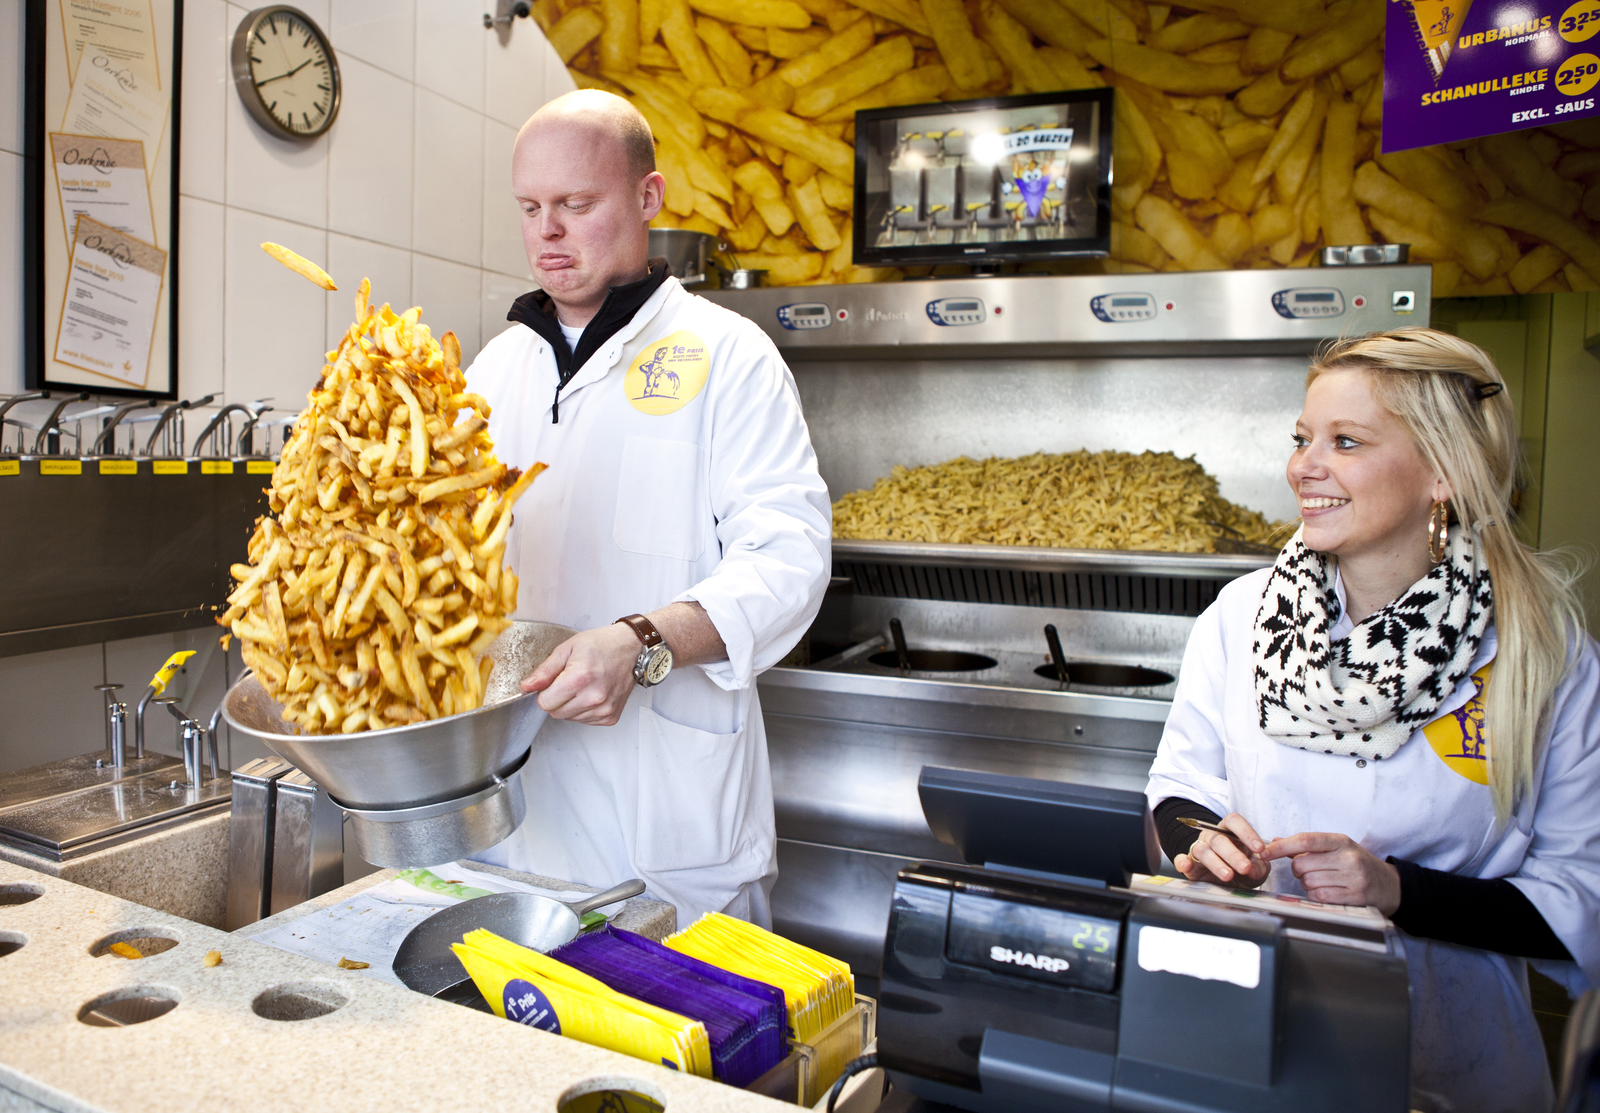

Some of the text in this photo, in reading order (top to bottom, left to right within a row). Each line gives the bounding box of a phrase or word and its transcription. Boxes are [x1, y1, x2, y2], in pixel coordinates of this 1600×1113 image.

[1458, 15, 1552, 49] URBANUS
[1505, 30, 1551, 47] NORMAAL
[1421, 68, 1549, 106] SCHANULLEKE
[1510, 83, 1545, 96] KINDER
[1512, 98, 1595, 123] EXCL. SAUS
[1072, 922, 1111, 953] 25
[990, 945, 1070, 973] SHARP
[517, 992, 537, 1012] Prijs
